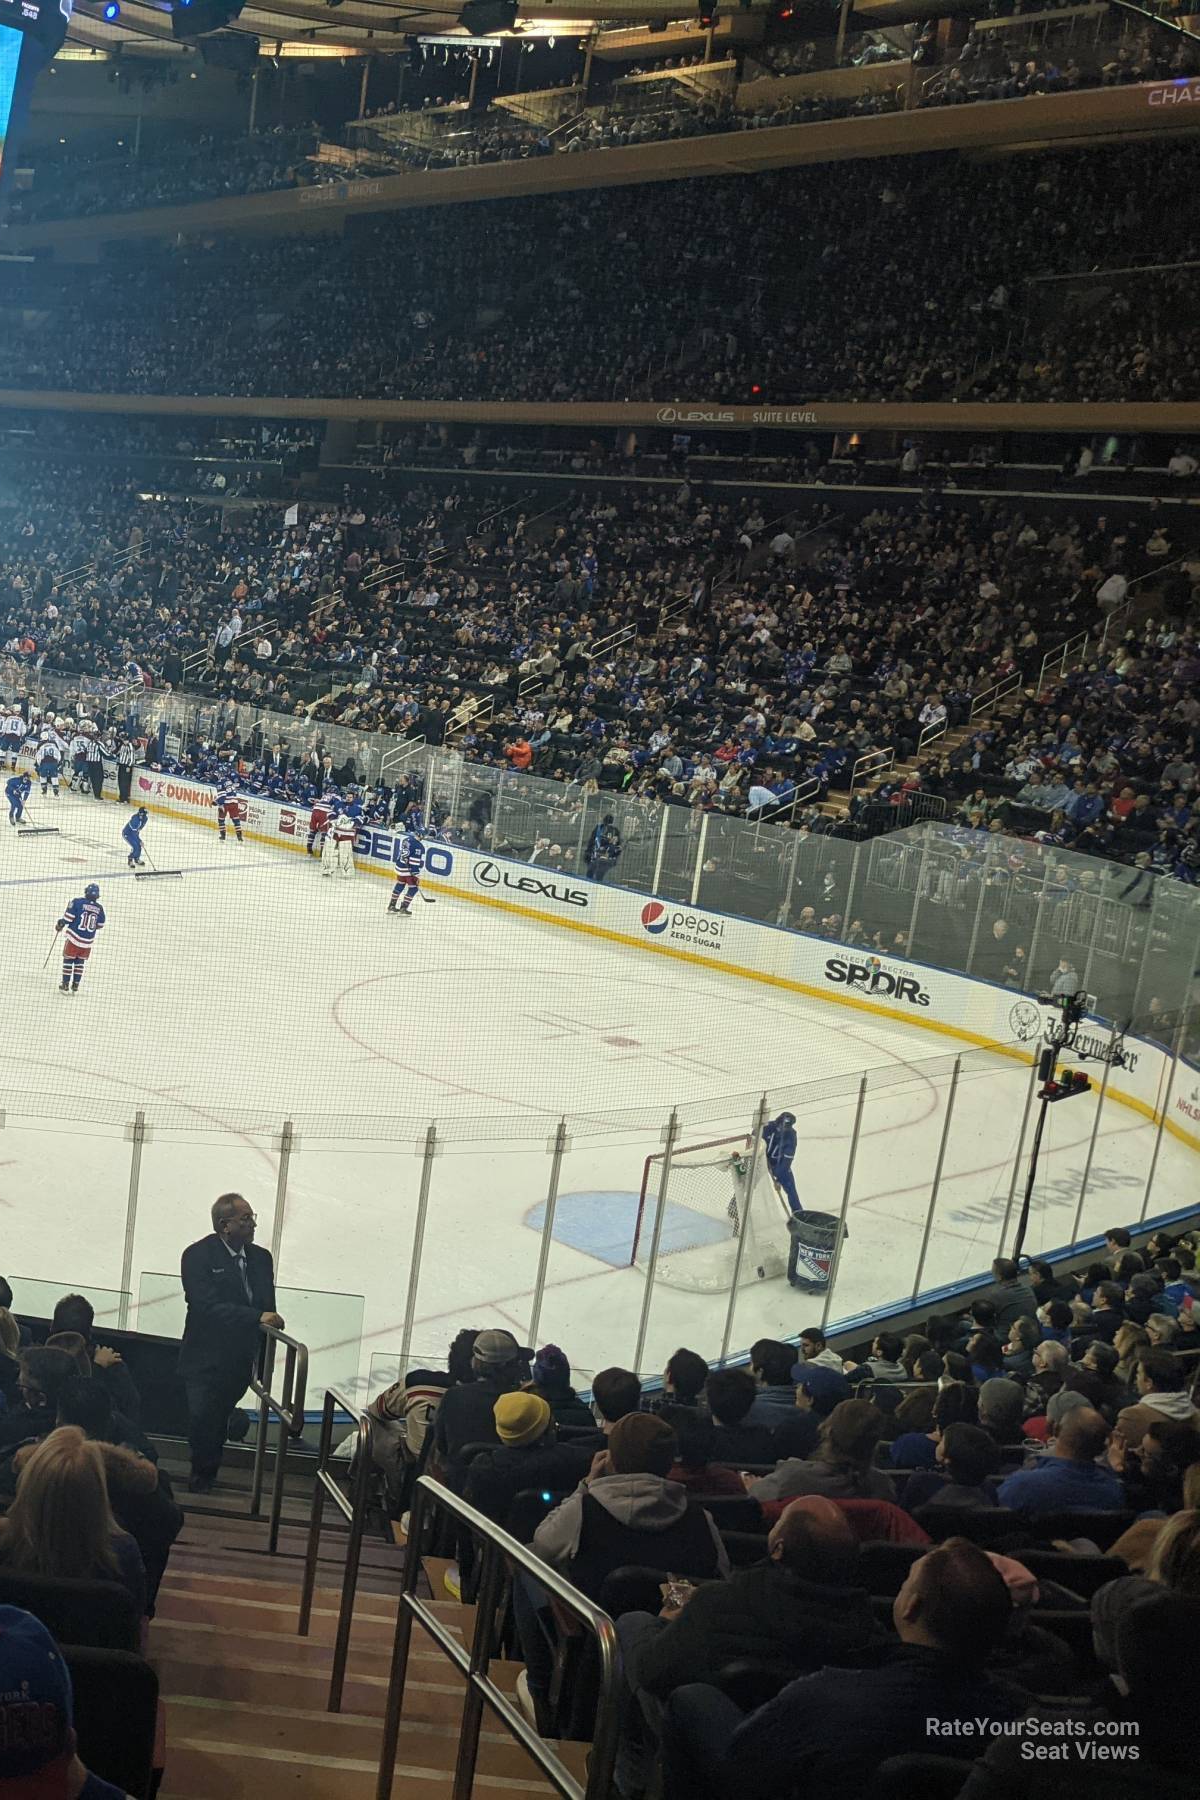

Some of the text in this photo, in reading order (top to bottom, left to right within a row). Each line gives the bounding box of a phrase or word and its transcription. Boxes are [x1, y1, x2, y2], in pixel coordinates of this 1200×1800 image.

[677, 411, 735, 423] LEXUS
[752, 411, 817, 424] SUITE LEVEL
[352, 826, 454, 877] GEIO
[503, 872, 589, 908] LEXUS
[77, 911, 97, 933] 10
[671, 911, 726, 938] pepsi
[670, 930, 722, 951] ZERO SUGAR
[835, 952, 915, 978] SELECT SECTOR
[800, 1246, 831, 1260] NEW YORK
